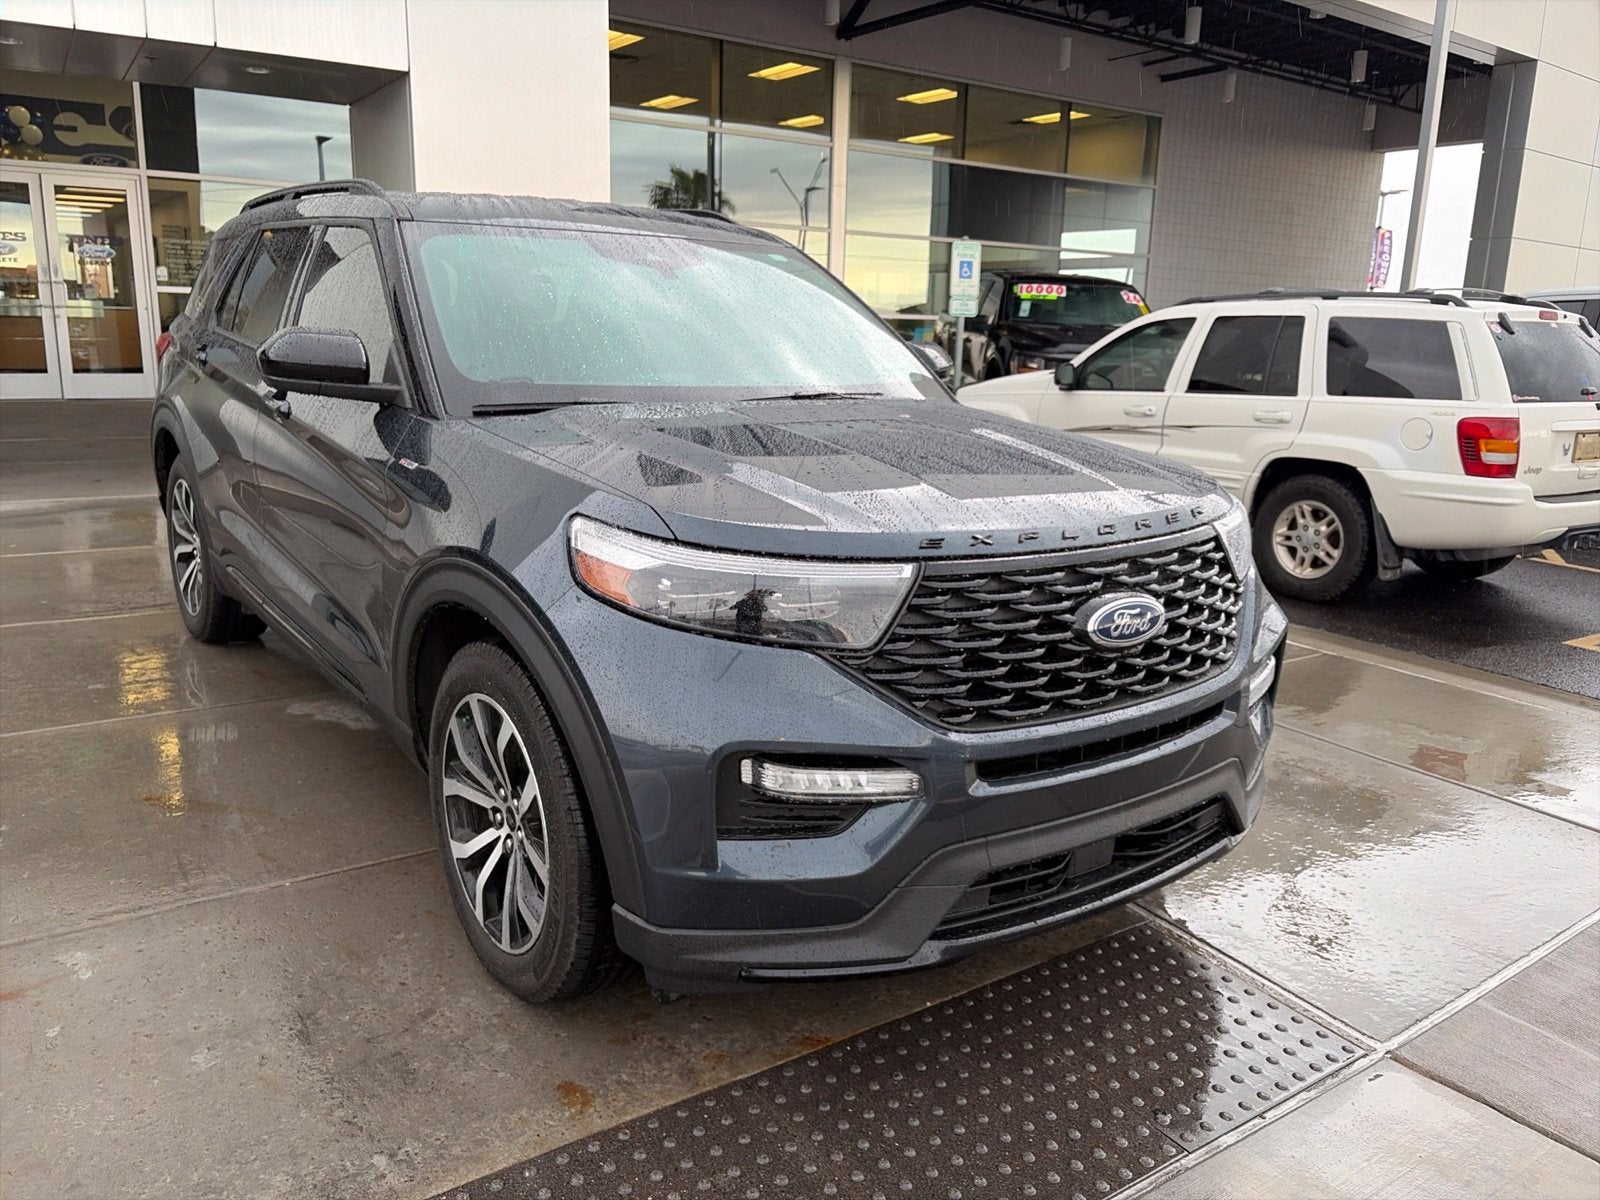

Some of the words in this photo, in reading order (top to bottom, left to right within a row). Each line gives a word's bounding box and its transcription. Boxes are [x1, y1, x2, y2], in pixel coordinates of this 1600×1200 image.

[1523, 465, 1543, 476] Jeep
[918, 505, 1205, 550] EXPLORER
[1110, 607, 1152, 638] Ford
